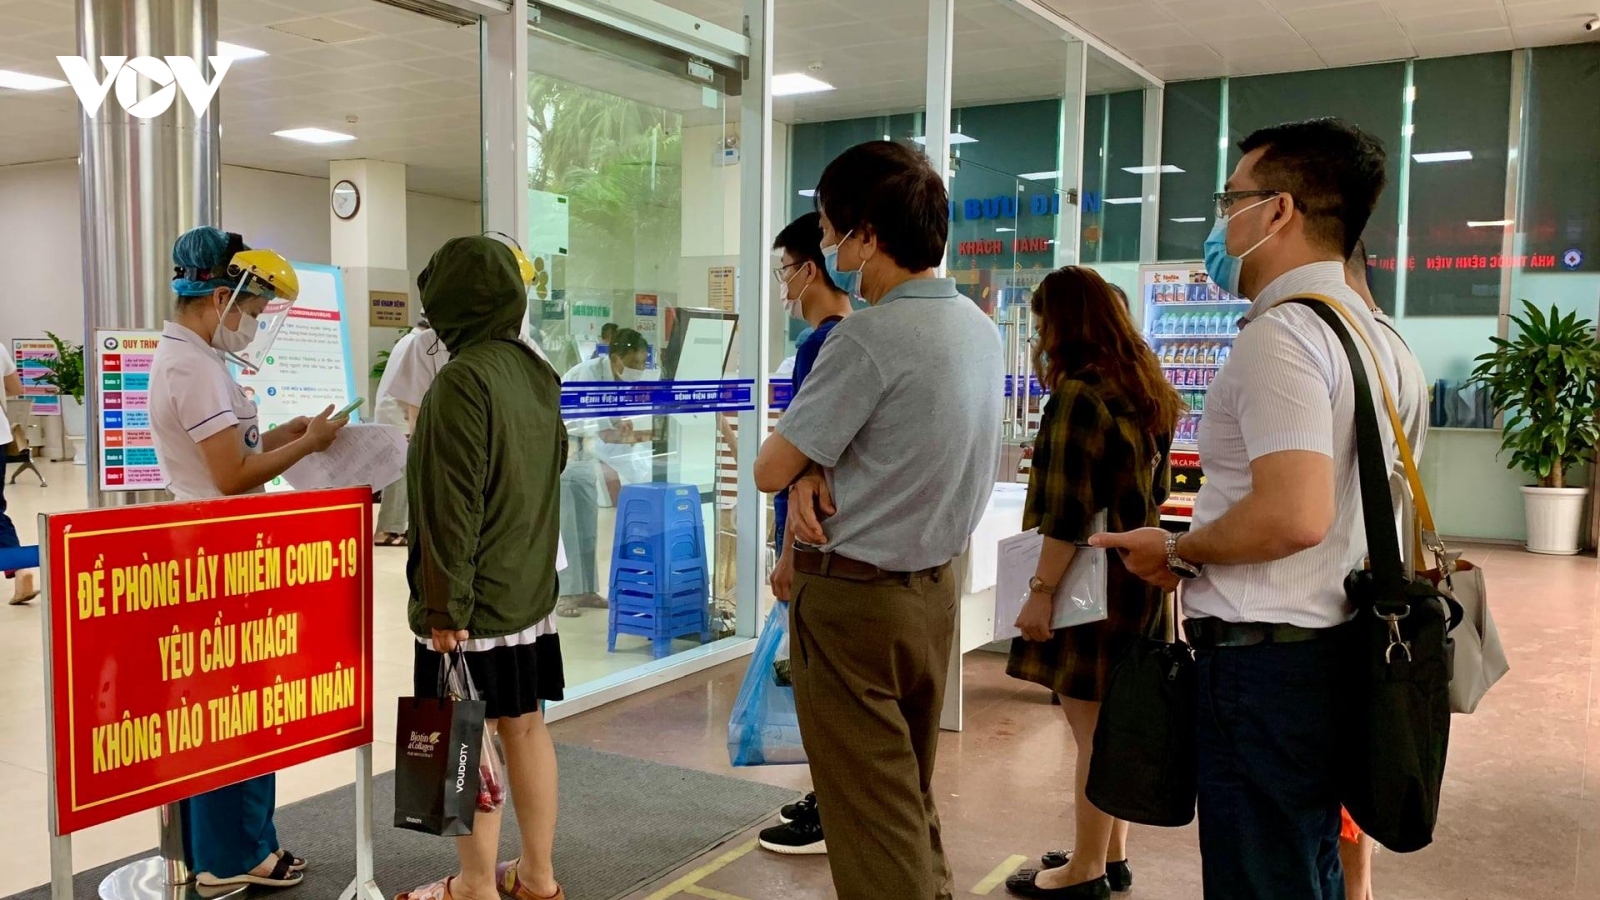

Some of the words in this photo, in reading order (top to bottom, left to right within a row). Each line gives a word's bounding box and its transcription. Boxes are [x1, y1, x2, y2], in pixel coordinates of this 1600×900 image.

[964, 194, 1019, 220] BƯU
[1030, 191, 1101, 215] ĐIN
[122, 339, 138, 349] QUY
[140, 337, 160, 349] TRÌN
[77, 553, 106, 620] ĐỀ
[112, 552, 179, 615] PHÒNG
[185, 547, 219, 602] LÂY
[224, 533, 281, 597] NHIỄM
[286, 537, 357, 587] COVID-19
[158, 625, 194, 681] YÊU
[200, 611, 236, 672] CẦU
[241, 608, 298, 665] KHÁCH
[92, 710, 161, 774] KHÔNG
[166, 697, 203, 754] VÀO
[208, 685, 258, 743] THĂM
[263, 675, 307, 736] BỆNH
[311, 662, 355, 716] NHÂN
[410, 731, 429, 743] Biotin
[456, 743, 469, 793] VOUDIOTY
